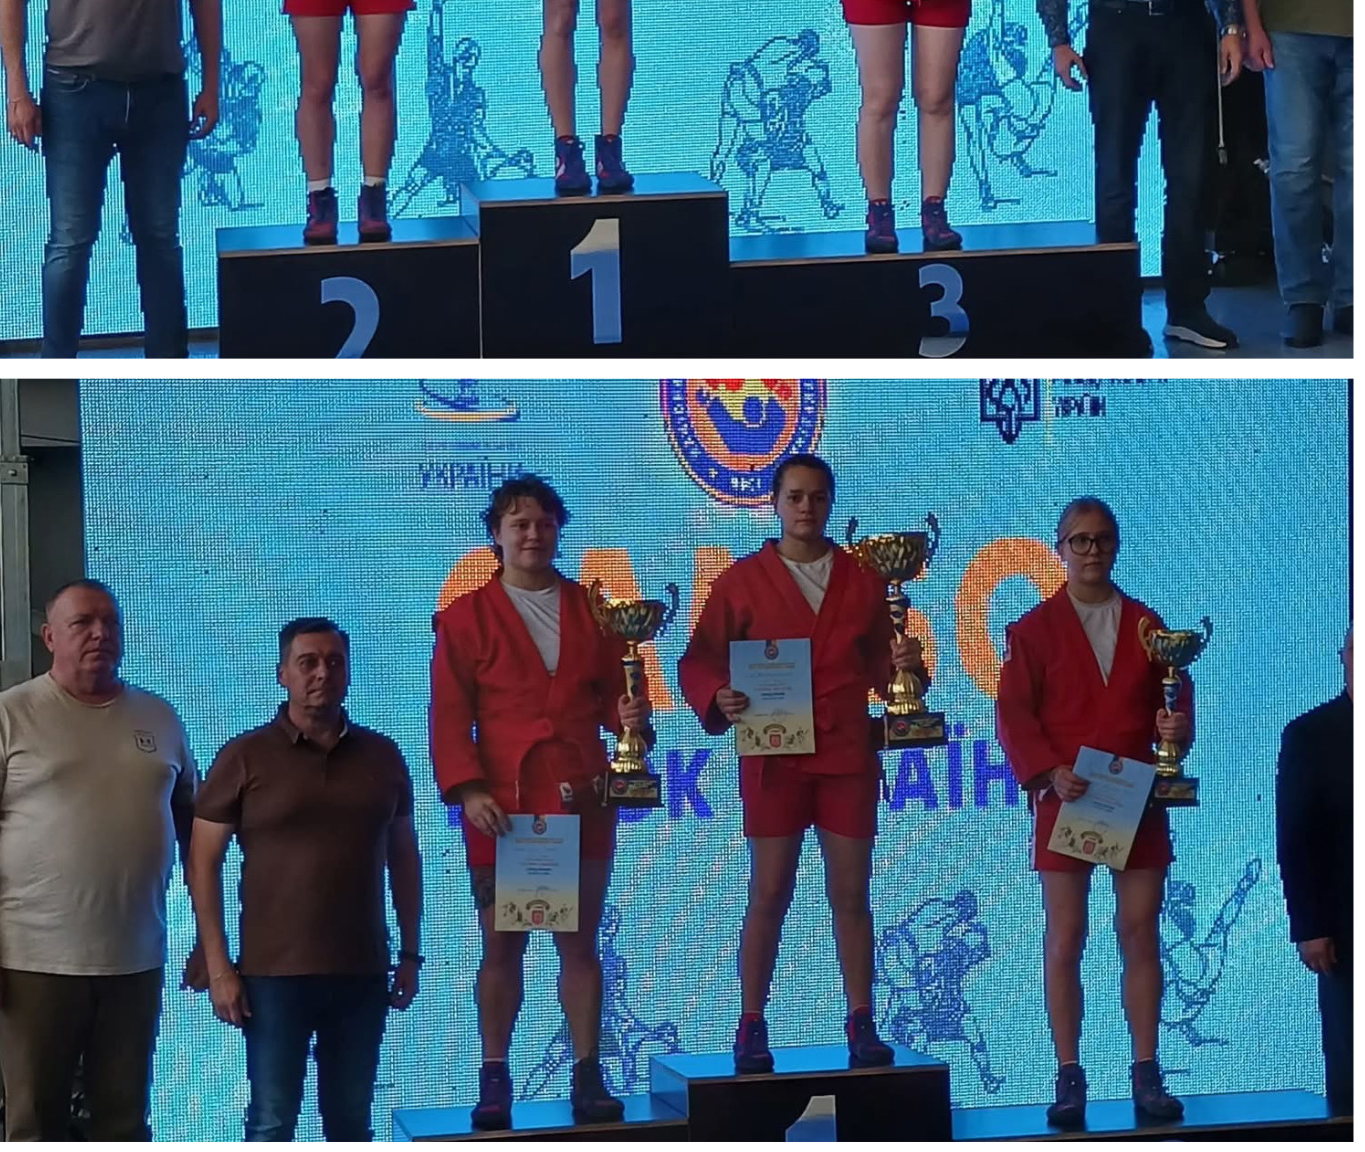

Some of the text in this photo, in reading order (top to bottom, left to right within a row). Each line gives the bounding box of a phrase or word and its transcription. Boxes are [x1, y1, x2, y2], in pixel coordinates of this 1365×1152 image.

[320, 264, 970, 359] 2 3
[570, 219, 622, 344] 1
